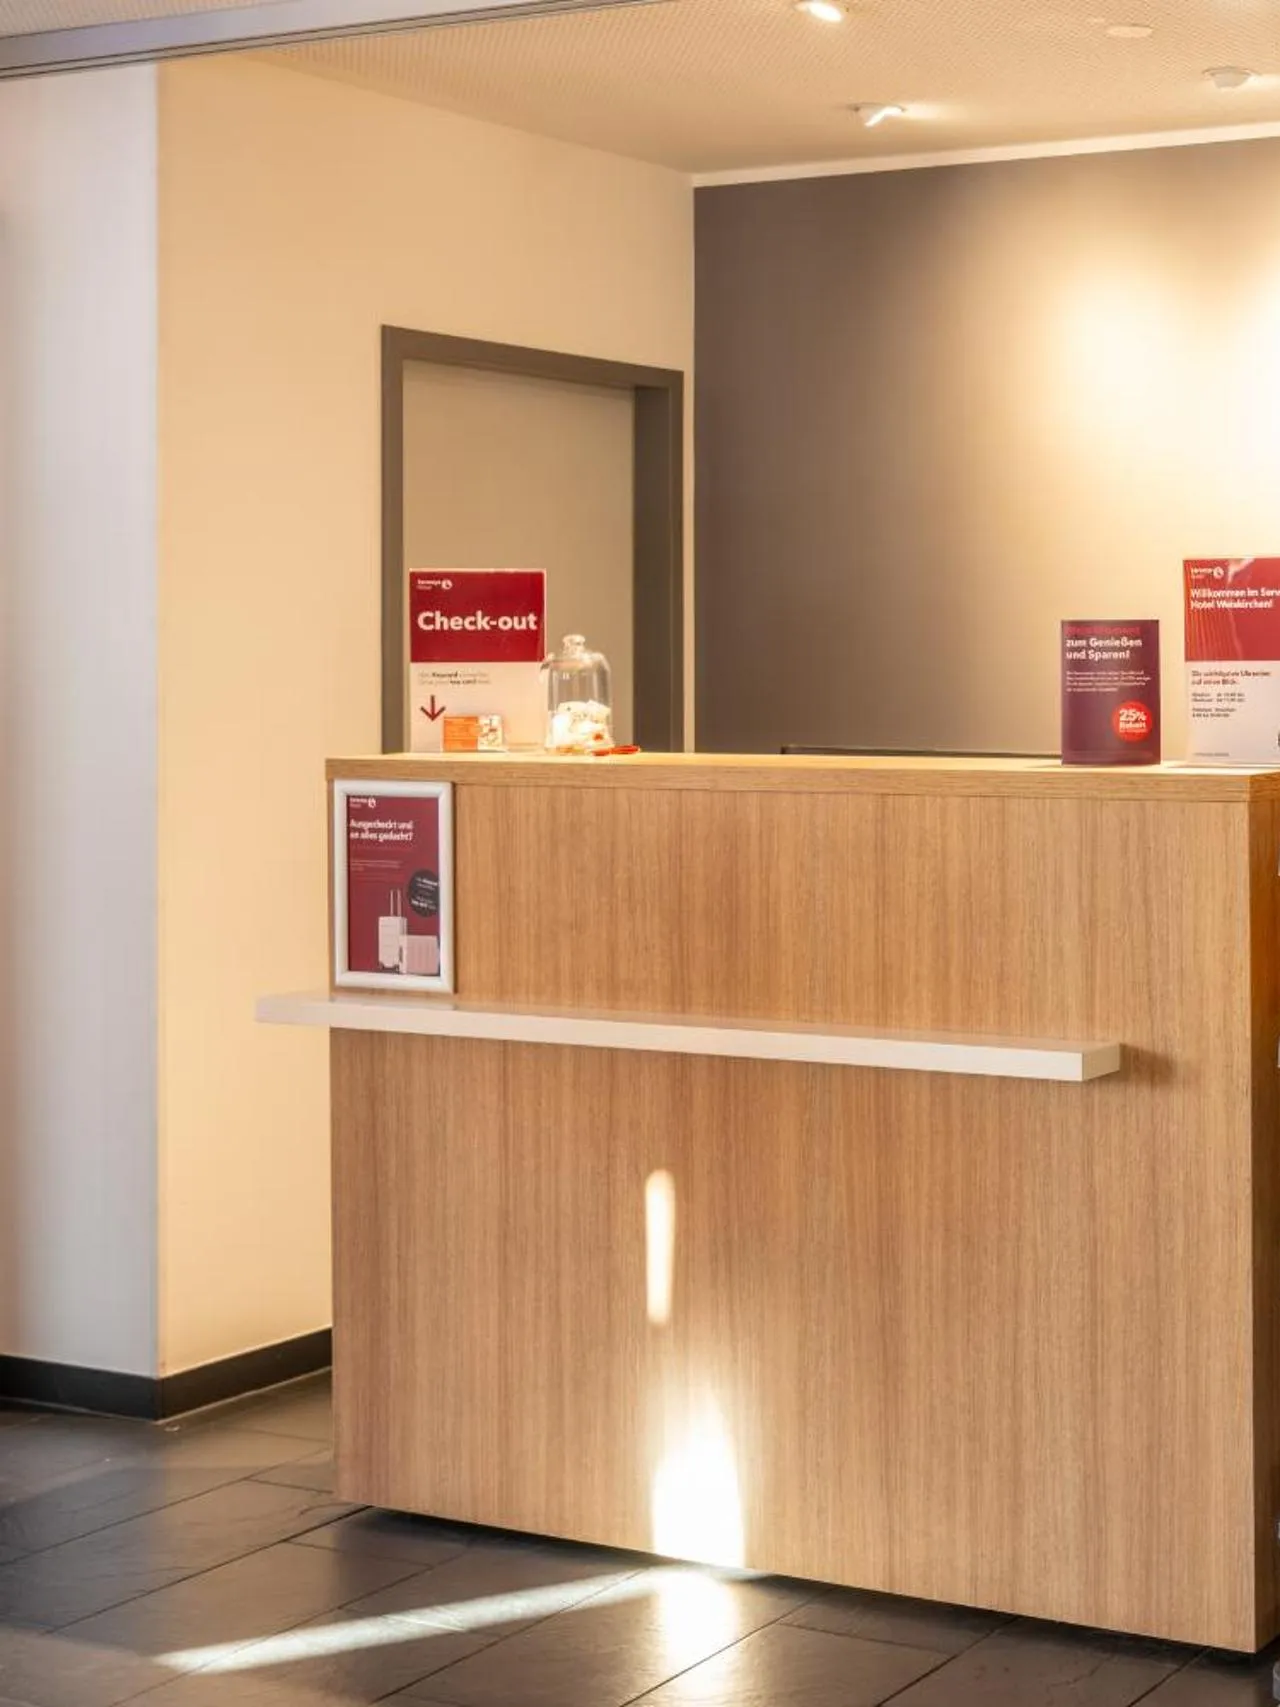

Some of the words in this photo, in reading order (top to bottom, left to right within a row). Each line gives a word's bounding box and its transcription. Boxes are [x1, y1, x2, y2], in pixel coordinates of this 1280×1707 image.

[1191, 588, 1246, 598] Willkommen
[1247, 587, 1258, 597] im
[1191, 600, 1214, 609] Hotel
[417, 610, 537, 631] Check-out
[1066, 639, 1086, 648] zum
[1089, 637, 1142, 648] Genießen
[1066, 649, 1086, 659] und
[1088, 649, 1130, 661] Sparen!
[1119, 709, 1147, 722] 25%
